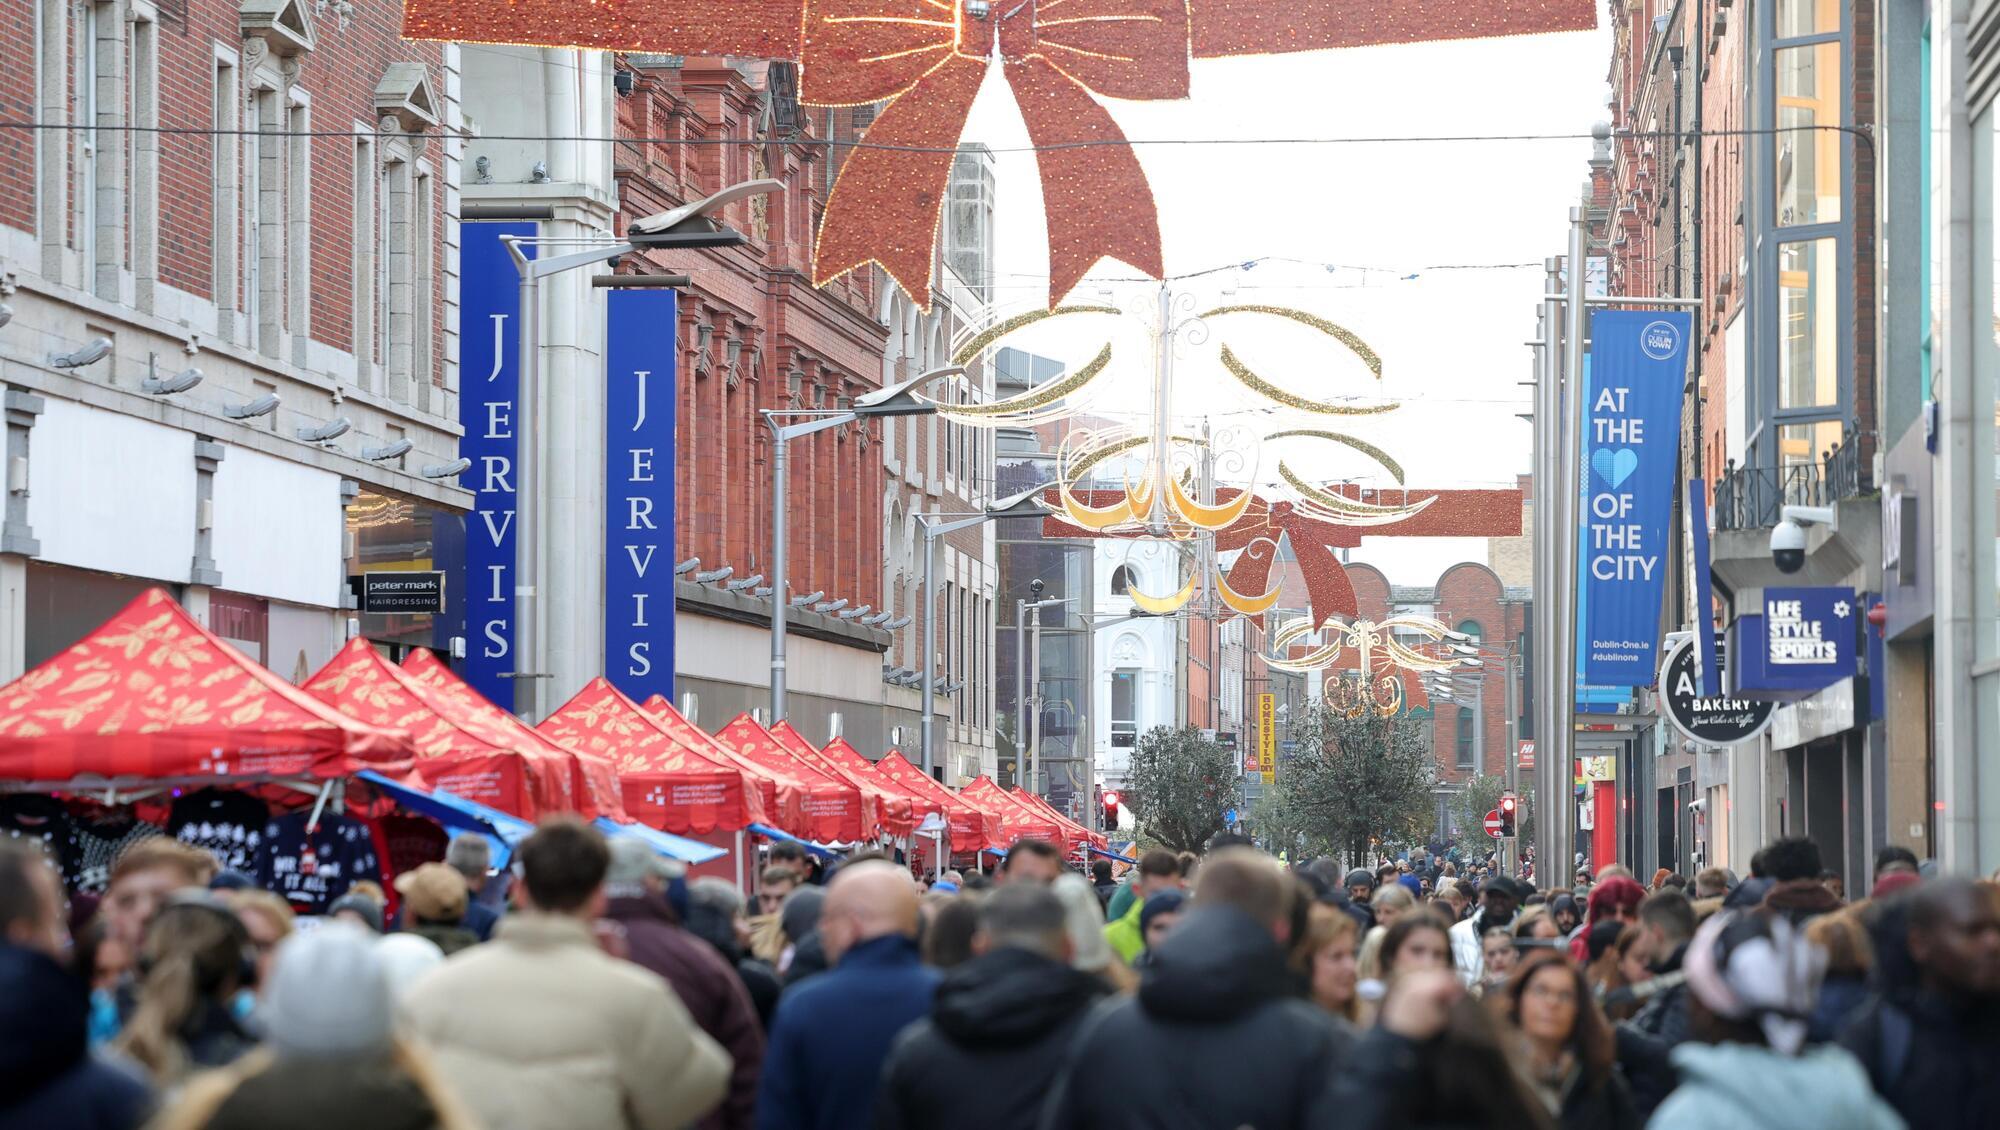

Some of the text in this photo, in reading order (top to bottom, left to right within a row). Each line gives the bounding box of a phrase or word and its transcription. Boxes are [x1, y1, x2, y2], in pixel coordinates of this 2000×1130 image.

[1648, 341, 1672, 350] TOWN
[1594, 387, 1630, 413] AT
[1594, 419, 1643, 444] THE
[479, 314, 515, 659] JERVIS
[1592, 493, 1633, 519] OF
[624, 370, 657, 677] JERVIS
[1591, 524, 1642, 550] THE
[1591, 555, 1658, 581] CITY
[369, 580, 437, 591] peter mark
[1768, 600, 1802, 617] LIFE
[1769, 621, 1822, 638] STYLE
[1593, 640, 1650, 650] Dublin-One.ie
[1769, 641, 1837, 659] SPORTS
[1592, 652, 1639, 662] #dublinone
[1692, 698, 1750, 712] BAKERY
